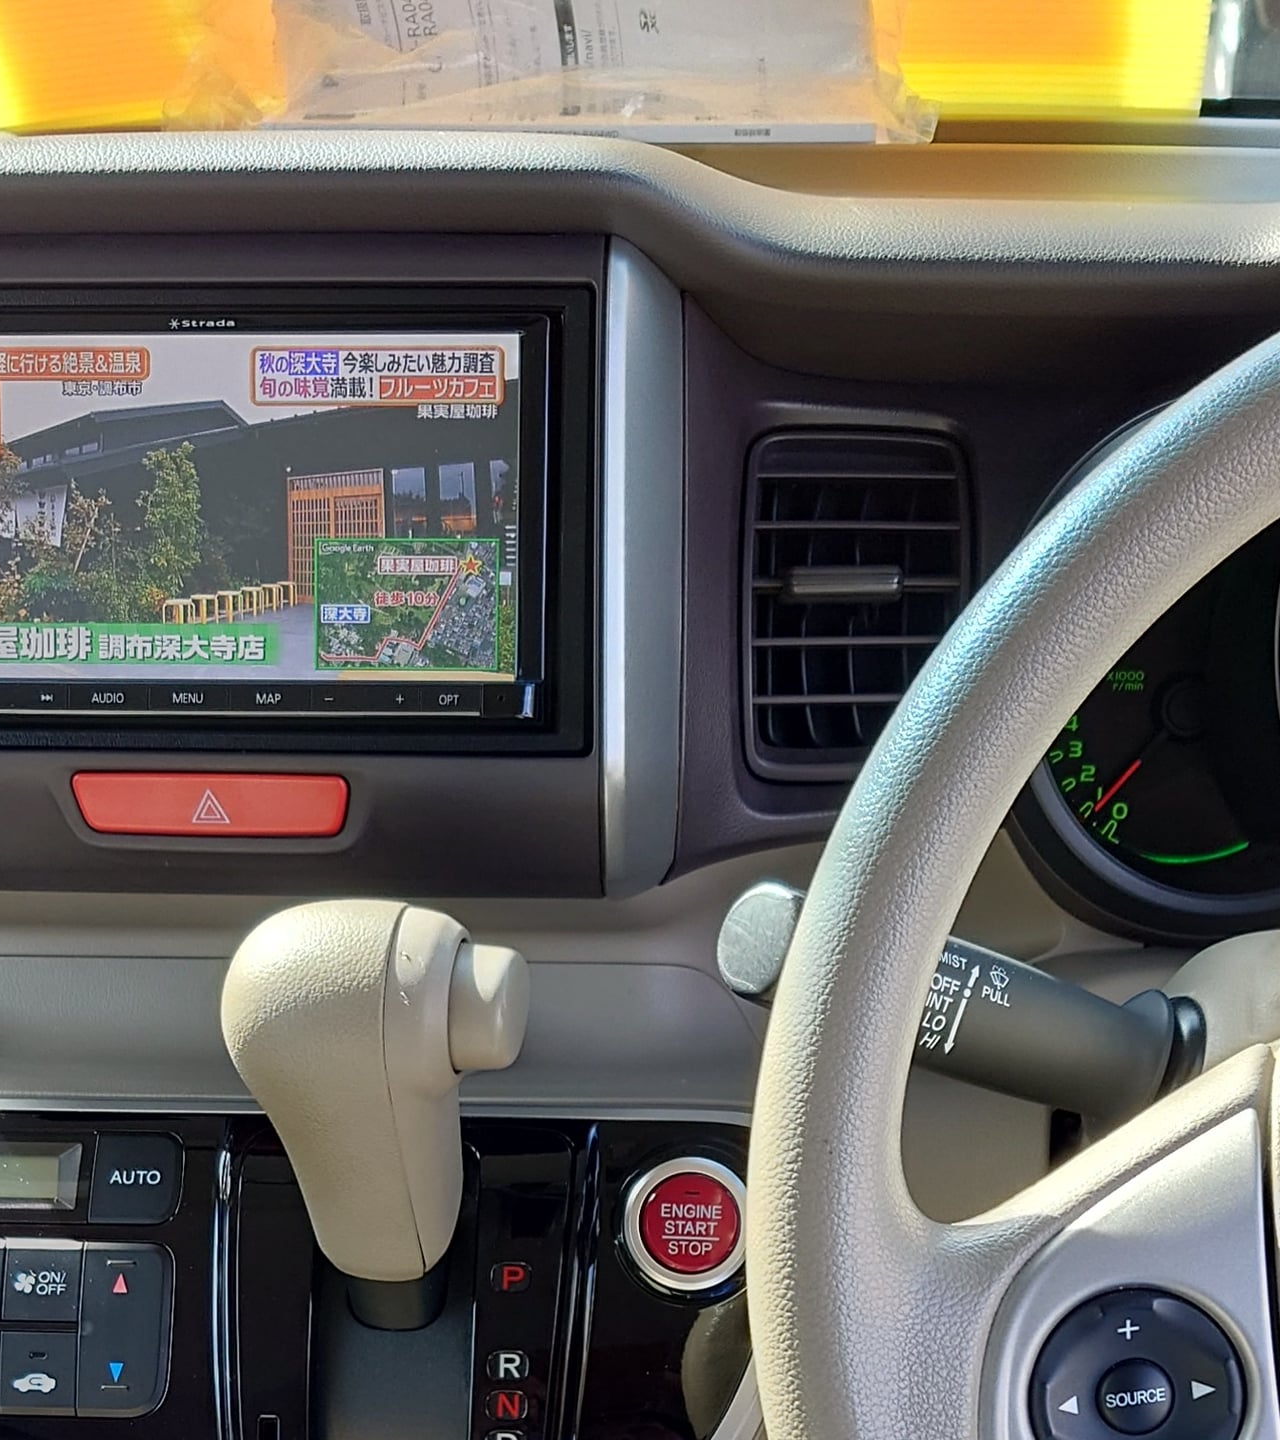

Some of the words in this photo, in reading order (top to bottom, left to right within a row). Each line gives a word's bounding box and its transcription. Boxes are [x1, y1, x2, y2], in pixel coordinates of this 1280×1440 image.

[180, 318, 236, 329] Strada
[259, 352, 338, 374] 秋の深大寺
[342, 351, 496, 374] 今楽しみたい魅力調査
[380, 376, 497, 399] フルーツカフェ
[416, 404, 498, 420] 果実屋珈琲
[323, 606, 368, 622] 深大寺
[98, 633, 266, 662] 調布深大寺店
[1112, 682, 1144, 692] r/min
[91, 691, 125, 704] AUDIO
[172, 692, 204, 705] MENU
[255, 692, 282, 705] MAP
[438, 693, 460, 706] OPT
[1065, 714, 1079, 732] 4
[1068, 740, 1083, 758] 3
[1080, 765, 1096, 782] 2
[1112, 803, 1128, 820] 0
[938, 951, 968, 971] MIST
[930, 972, 961, 996] OFF
[925, 990, 954, 1013] INT
[981, 985, 1011, 1008] PULL
[921, 1011, 946, 1031] LO
[919, 1031, 941, 1050] HI
[110, 1170, 161, 1186] AUTO
[660, 1203, 723, 1220] ENGINE
[664, 1220, 718, 1236] START
[667, 1240, 714, 1256] STOP
[37, 1270, 67, 1285] ON/
[501, 1266, 526, 1290] P
[36, 1283, 67, 1297] OFF
[498, 1353, 521, 1378] R
[495, 1394, 519, 1418] N
[1105, 1387, 1167, 1409] SOURCE
